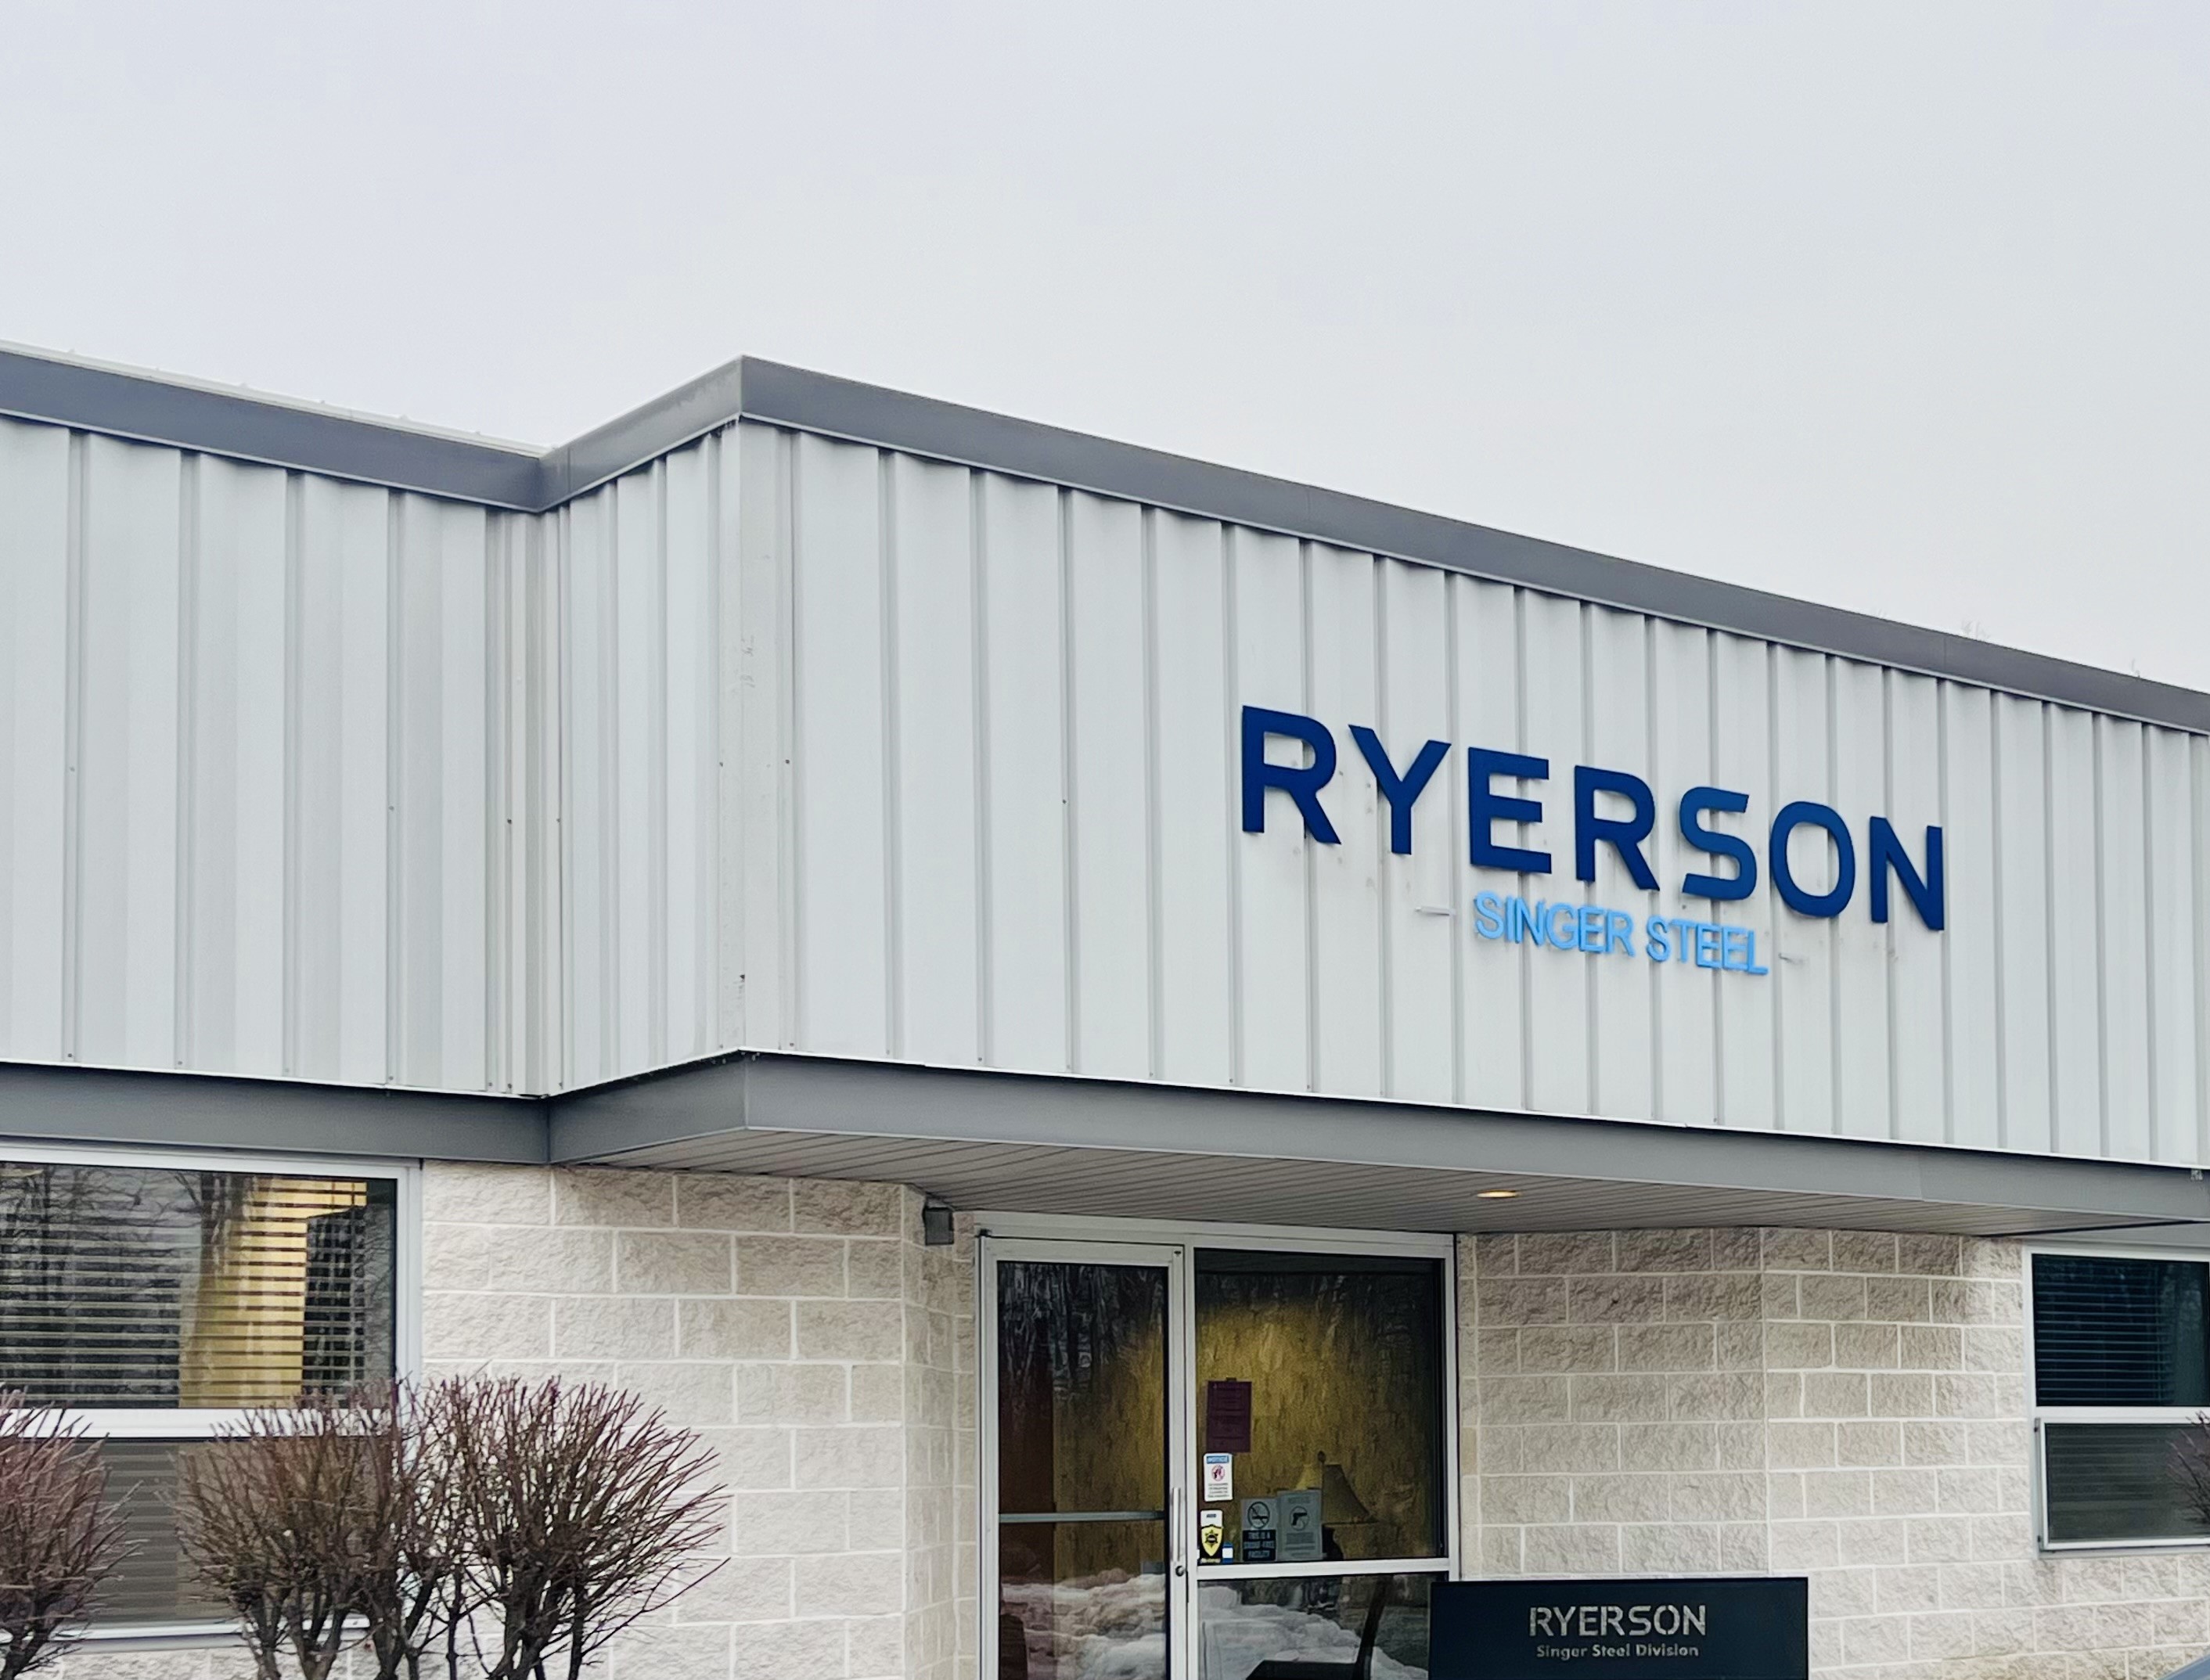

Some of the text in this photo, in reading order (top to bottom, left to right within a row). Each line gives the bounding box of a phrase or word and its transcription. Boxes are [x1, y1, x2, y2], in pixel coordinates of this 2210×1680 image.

[1242, 706, 1945, 930] RYERSON
[1475, 891, 1769, 975] SINGER STEEL
[1529, 1605, 1706, 1636] RYERSON
[1537, 1644, 1699, 1660] Singer Steel Division
